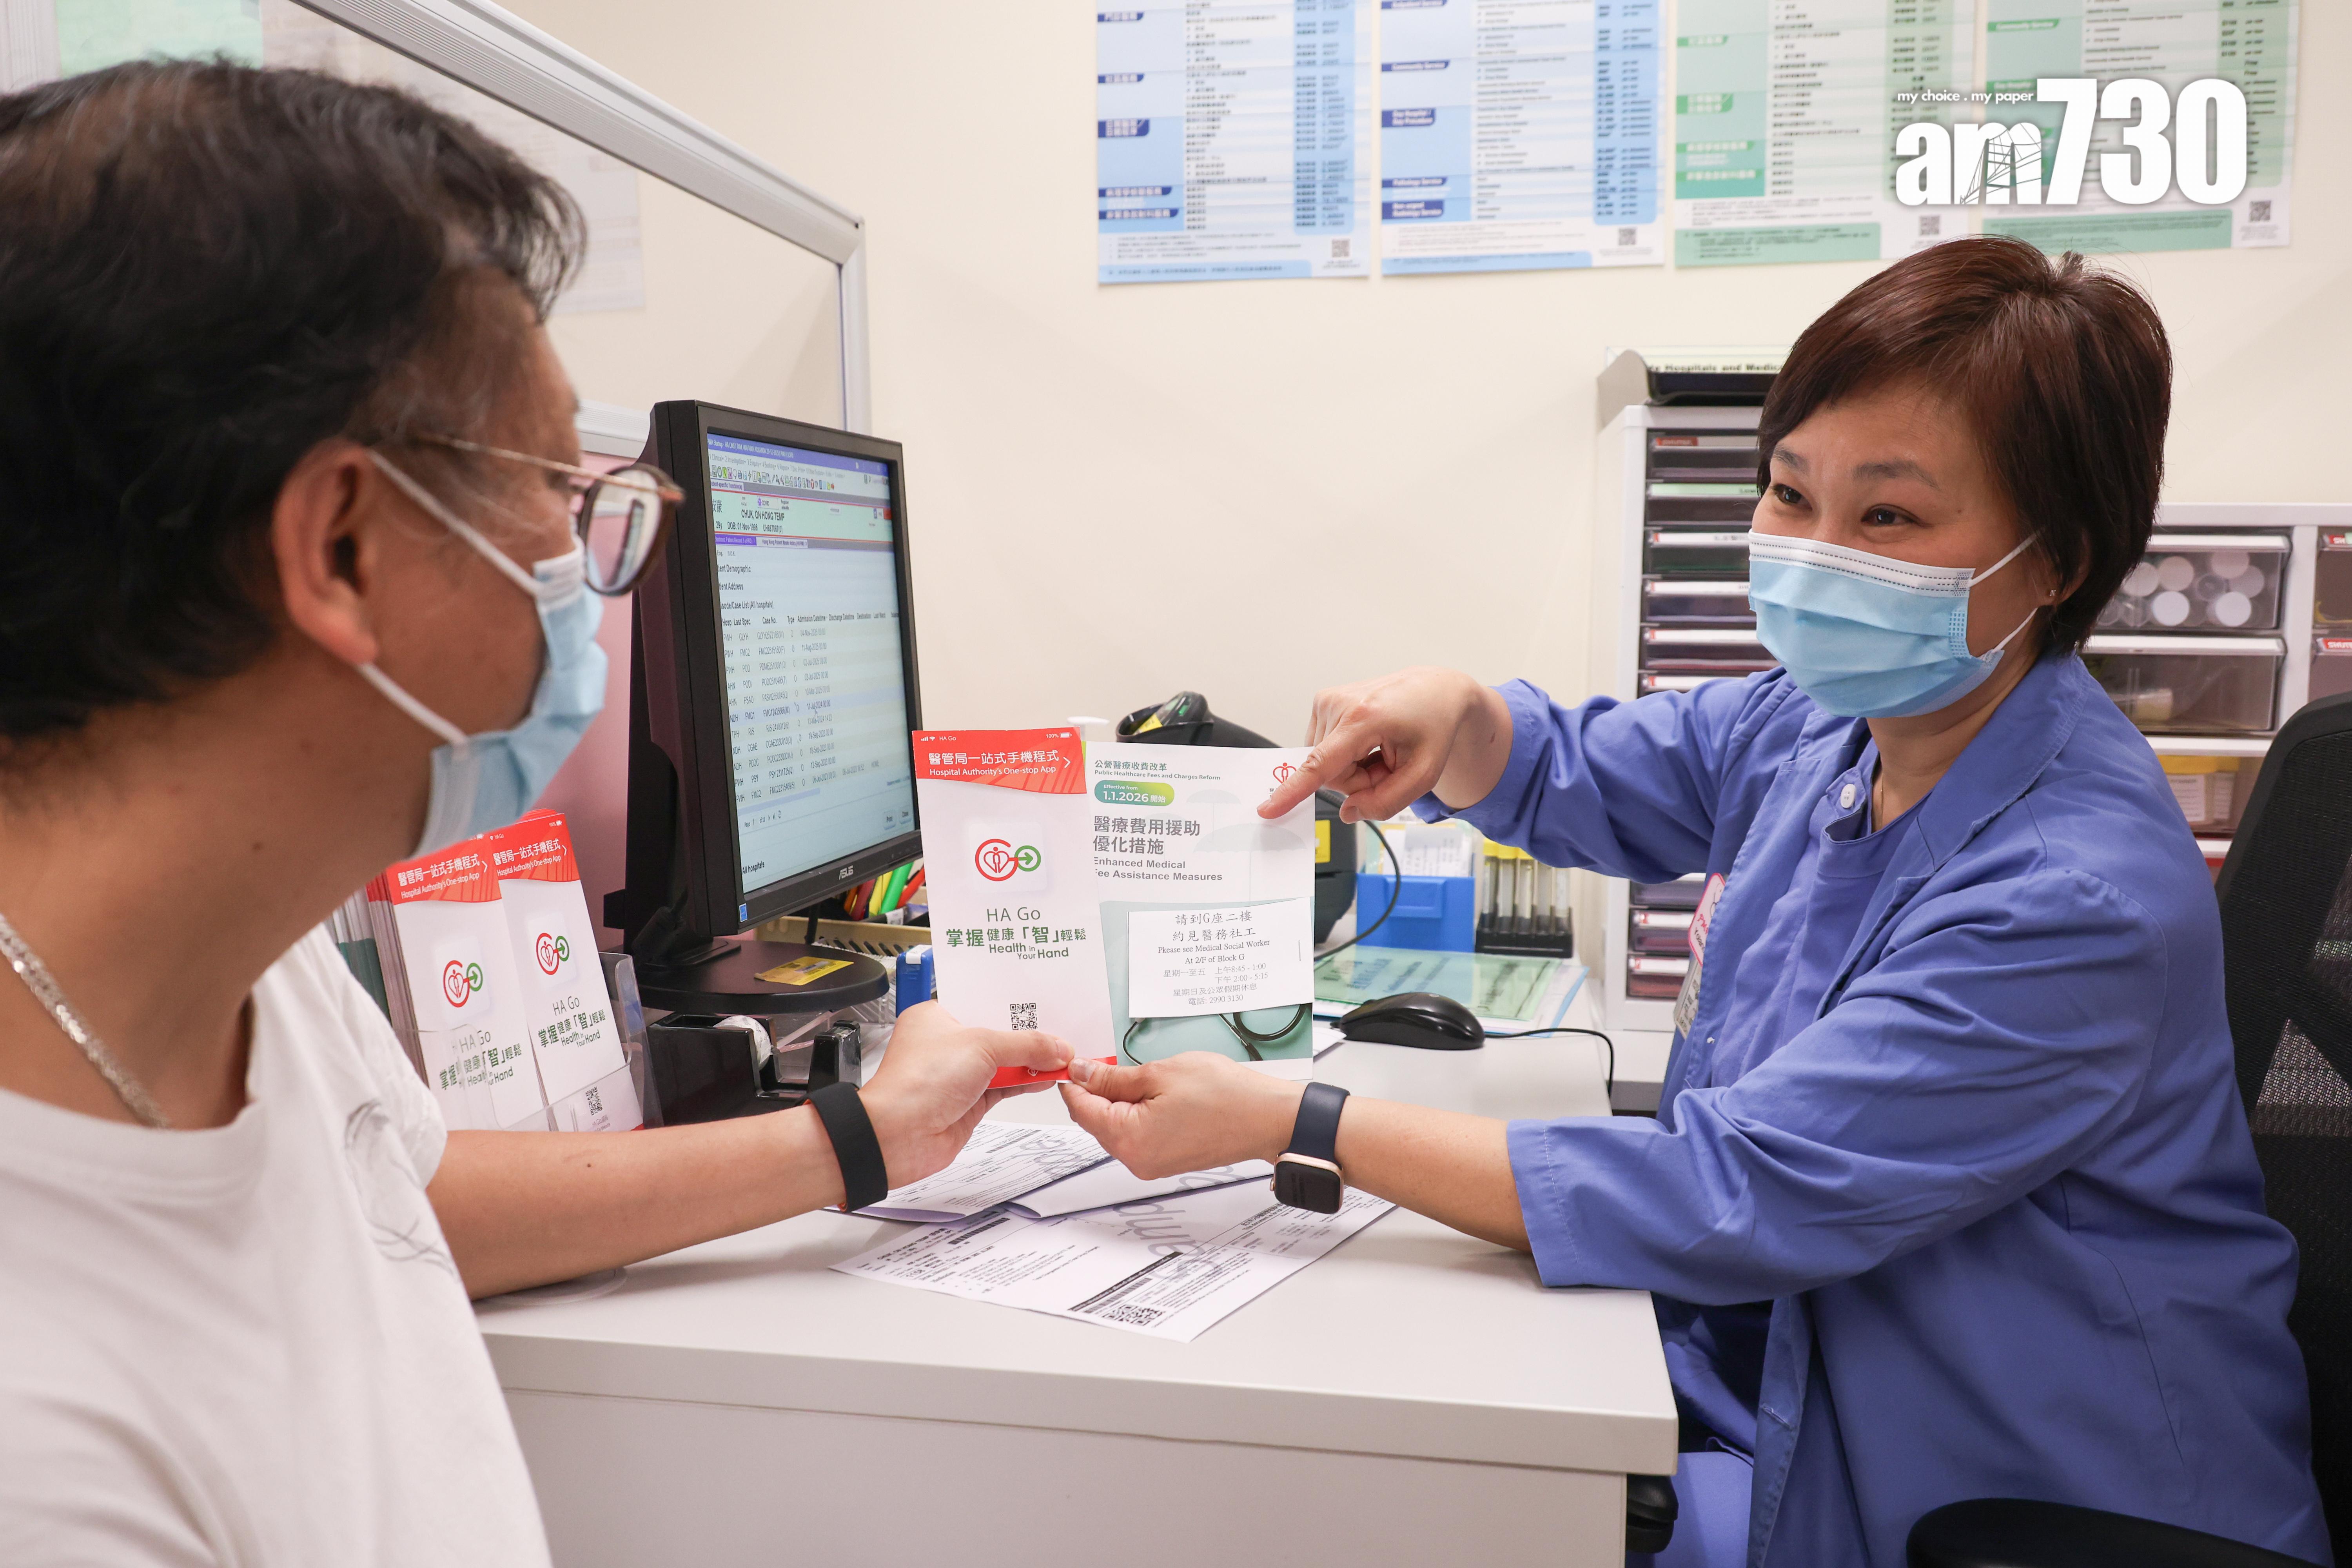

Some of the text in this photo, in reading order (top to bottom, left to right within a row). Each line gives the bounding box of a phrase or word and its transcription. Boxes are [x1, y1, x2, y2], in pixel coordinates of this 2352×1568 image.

[741, 509, 784, 521] CHUK, ON HONG TEMP
[727, 564, 751, 574] Demographic
[757, 601, 774, 610] hospitals)
[722, 619, 731, 627] Hosp
[742, 617, 751, 626] Spec.
[745, 712, 755, 720] FMC1
[928, 750, 1059, 765] 醫管局一站式手機程式
[929, 768, 960, 777] Hospital
[1004, 766, 1038, 775] One-stop
[1040, 765, 1056, 774] App
[1095, 760, 1167, 771] 公營醫療收費改革
[1103, 791, 1166, 803] 1.1.2026 開始
[1094, 815, 1200, 837] 醫療費用援助
[493, 838, 561, 866] 醫管局一站式手機程式
[1093, 835, 1164, 855] 優化措施
[397, 853, 480, 887] 醫管局一站式手機程式
[497, 866, 513, 876] Hospital
[534, 857, 552, 867] One-stop
[748, 861, 764, 873] hospitals
[1146, 860, 1185, 869] Medical
[839, 866, 853, 880] ASUS
[1095, 869, 1110, 878] ee
[1113, 870, 1170, 880] Assistance
[401, 886, 421, 899] Hospital
[446, 875, 469, 886] One-stop
[987, 907, 1040, 922] HA Go
[1175, 910, 1252, 926] 請到G座二樓
[1172, 928, 1256, 942] 約見醫務社工
[989, 942, 1026, 953] Health
[1038, 947, 1069, 958] Hand
[1163, 968, 1206, 978] 星期一至五
[1215, 965, 1245, 975] 上午8:45
[1215, 976, 1231, 984] 下午
[1254, 972, 1268, 980] 5:15
[1173, 983, 1257, 997] 星期日及公眾假期休息
[553, 996, 579, 1016] HA Go
[1188, 997, 1207, 1005] 電話:
[459, 1034, 476, 1053] HA
[561, 1031, 580, 1046] Health
[585, 1029, 601, 1044] Hand
[494, 1066, 513, 1083] Hand
